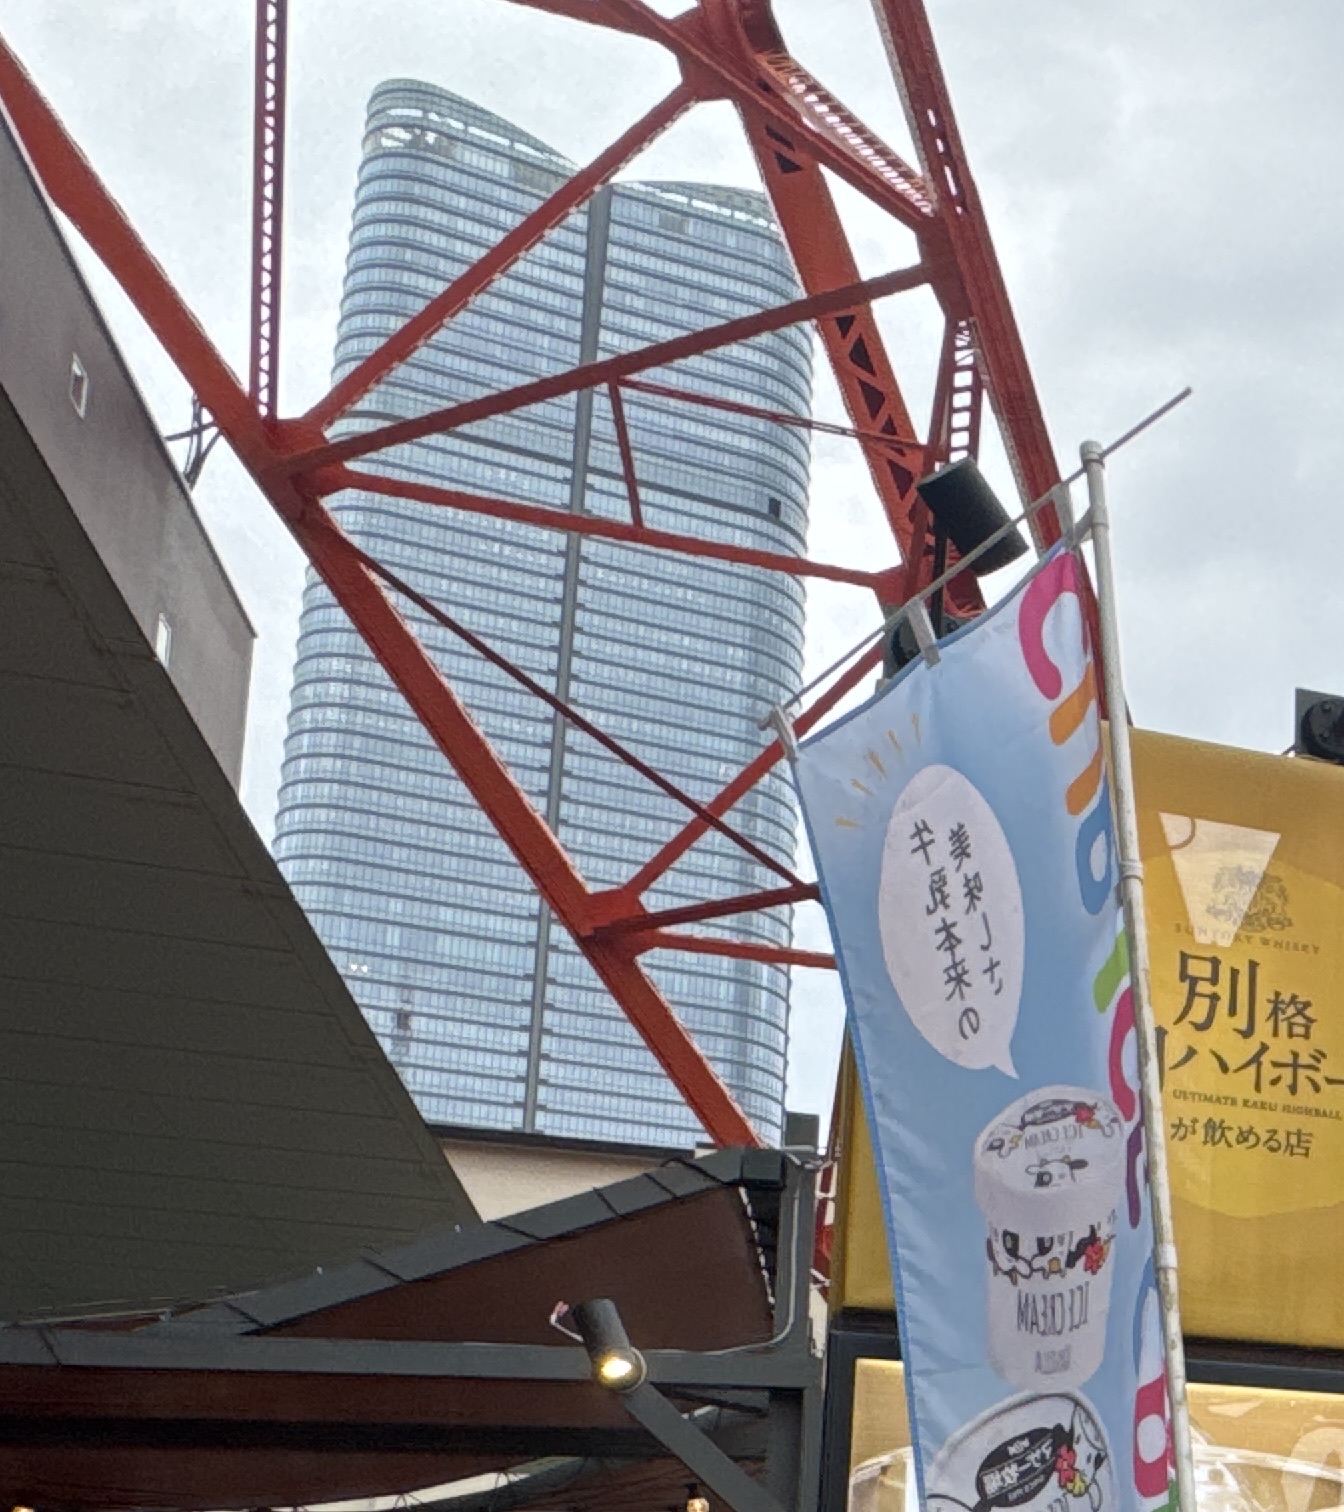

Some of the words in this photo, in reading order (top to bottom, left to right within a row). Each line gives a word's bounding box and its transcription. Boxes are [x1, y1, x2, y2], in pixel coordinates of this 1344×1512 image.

[1173, 951, 1317, 1040] 別格
[1172, 1089, 1238, 1107] ULTIMATE
[1170, 1117, 1313, 1158] が飲める店
